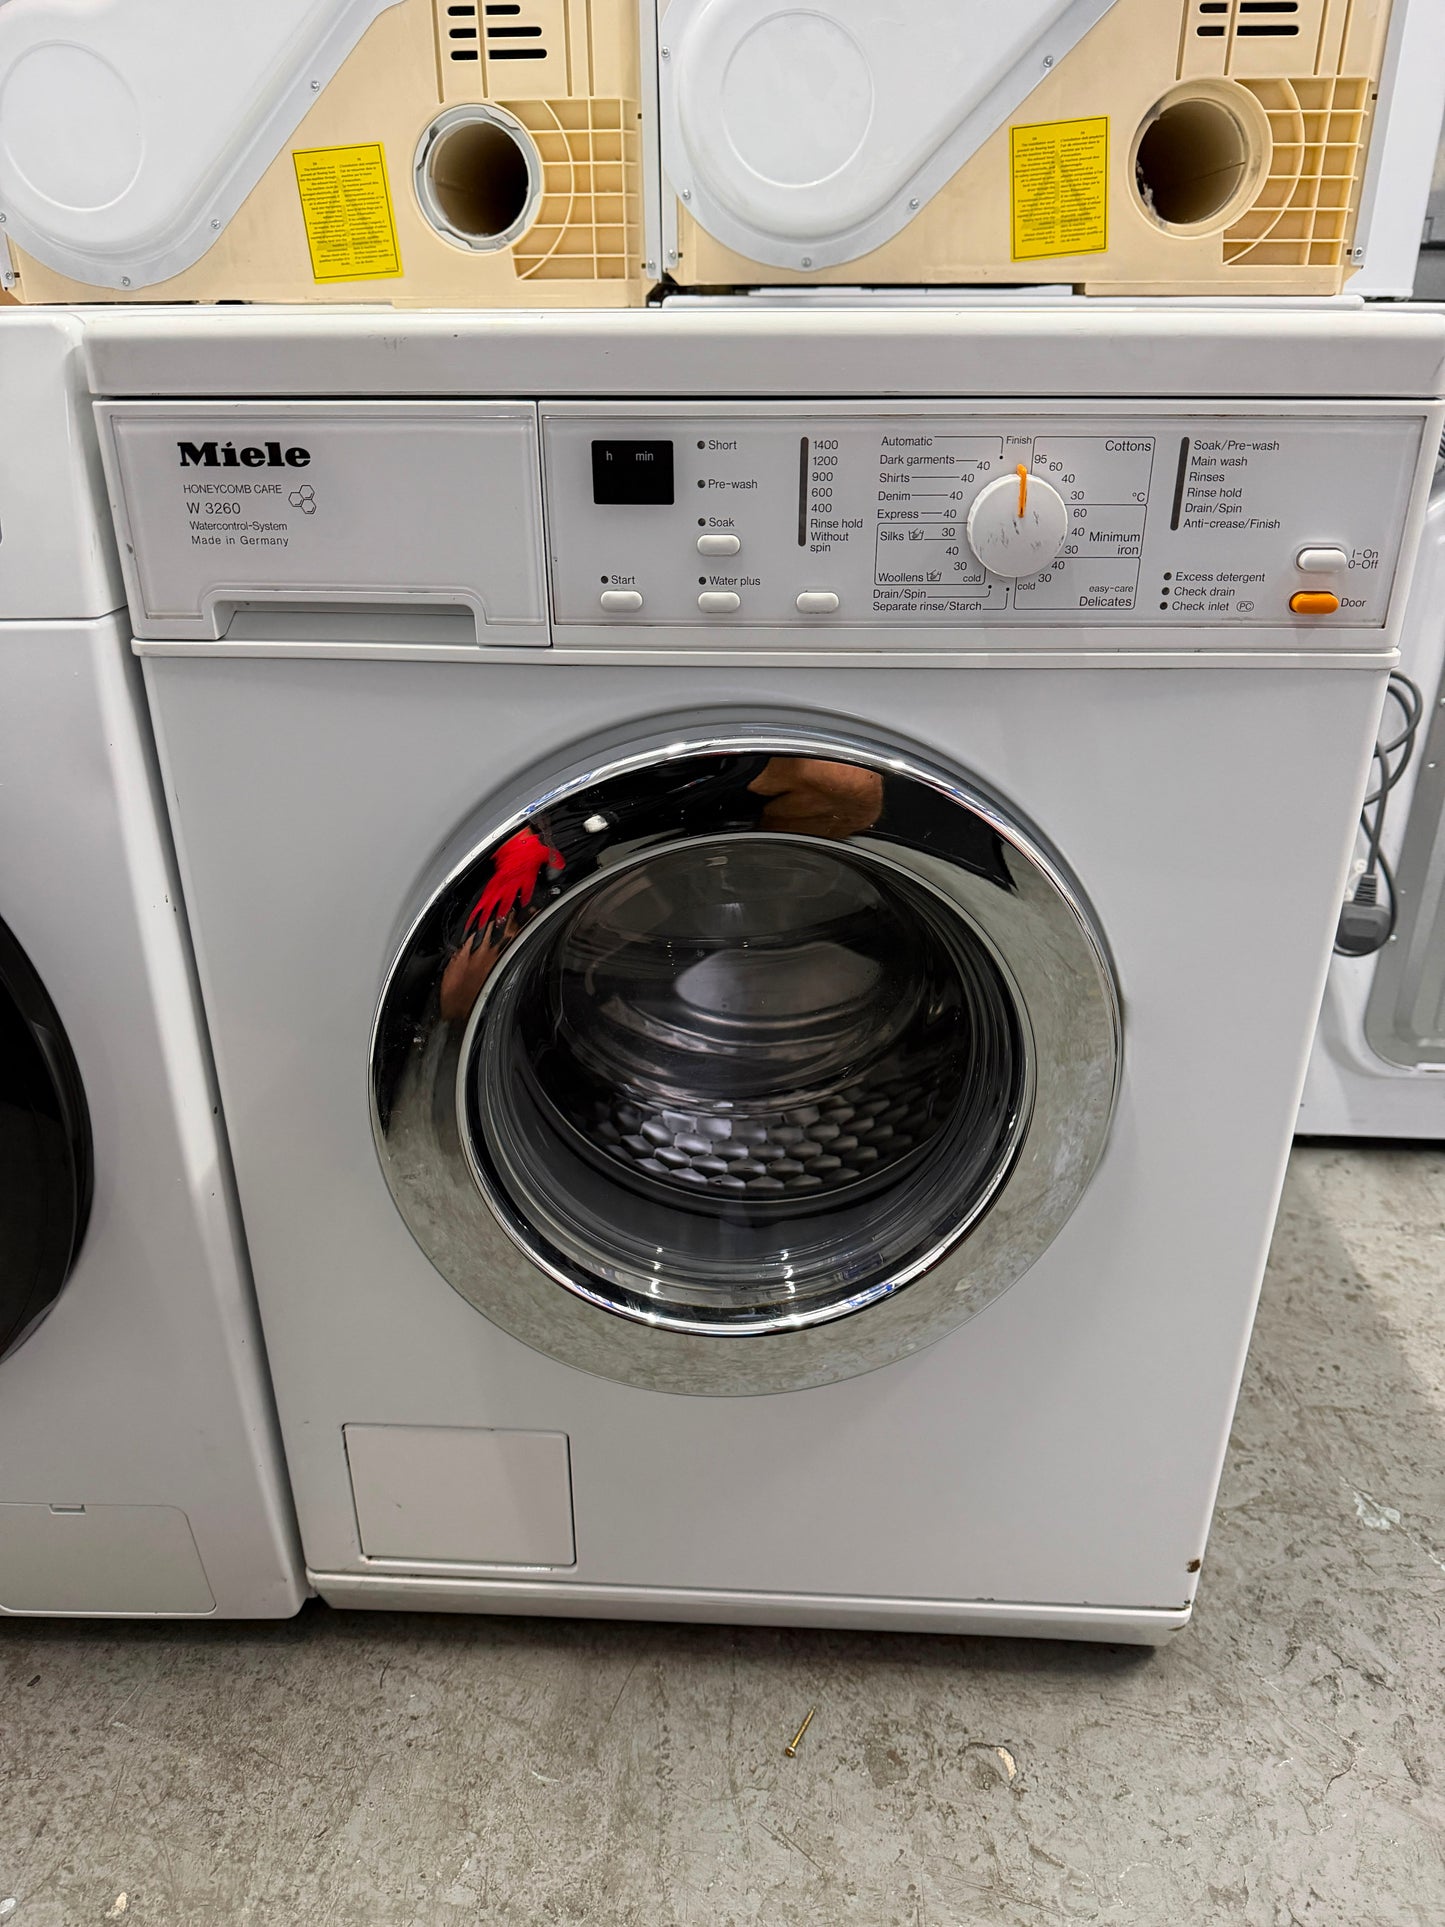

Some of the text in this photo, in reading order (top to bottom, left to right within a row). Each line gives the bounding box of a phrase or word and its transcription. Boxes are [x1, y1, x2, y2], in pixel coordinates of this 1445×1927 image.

[708, 440, 737, 450] Short
[813, 440, 838, 450] 1400
[881, 437, 933, 446] Automatic
[1006, 436, 1032, 445] Finish
[1194, 441, 1280, 450] Soak/Pre-wash
[1105, 441, 1151, 451] Cottons
[177, 441, 311, 468] Miele
[606, 451, 654, 461] h min
[1034, 455, 1047, 464] 95
[812, 456, 838, 466] 1200
[879, 455, 991, 470] Dark garments 40
[1191, 457, 1248, 466] Main wash
[1049, 462, 1063, 471] 60
[812, 472, 833, 482] 900
[879, 473, 975, 483] Shirts 40
[1062, 474, 1075, 483] 40
[1189, 472, 1225, 481] Rinses
[183, 484, 282, 494] HONEYCOMB CARE
[708, 479, 758, 489] Pre-wash
[811, 488, 833, 498] 600
[878, 491, 963, 501] Denim 40
[1070, 491, 1084, 500] 30
[1187, 488, 1242, 497] Rinse hold
[186, 502, 241, 514] W 3260
[811, 504, 832, 512] 400
[1185, 504, 1242, 514] Drain/Spin
[877, 509, 957, 520] Express 40
[1073, 509, 1087, 518] 60
[190, 521, 288, 531] Watercontrol-System
[709, 518, 734, 527] Soak
[810, 519, 863, 528] Rinse hold
[1183, 519, 1280, 529] Anti-crease/Finish
[810, 532, 848, 542] Without
[880, 528, 955, 541] Silks 30
[1071, 528, 1085, 536] 40
[1089, 532, 1141, 542] Minimum
[191, 535, 289, 547] Made in Germany
[810, 543, 831, 553] spin
[945, 546, 959, 556] 40
[1064, 545, 1078, 554] 30
[1117, 545, 1139, 555] iron
[953, 562, 967, 571] 30
[1051, 561, 1065, 570] 40
[611, 575, 635, 585] Start
[710, 576, 760, 586] Water plus
[879, 573, 981, 583] Woollens cold
[1038, 574, 1052, 583] 30
[1175, 573, 1265, 583] Excess detergent
[1017, 582, 1035, 591] cold
[1089, 585, 1134, 593] easy-care
[1174, 587, 1235, 596] Check drain
[873, 589, 926, 599] Drain/Spin
[873, 601, 982, 611] Separate rinse/Starch
[1079, 597, 1132, 607] Delicates
[1172, 602, 1205, 611] Check
[1208, 602, 1229, 611] inlet
[1341, 598, 1366, 607] Door
